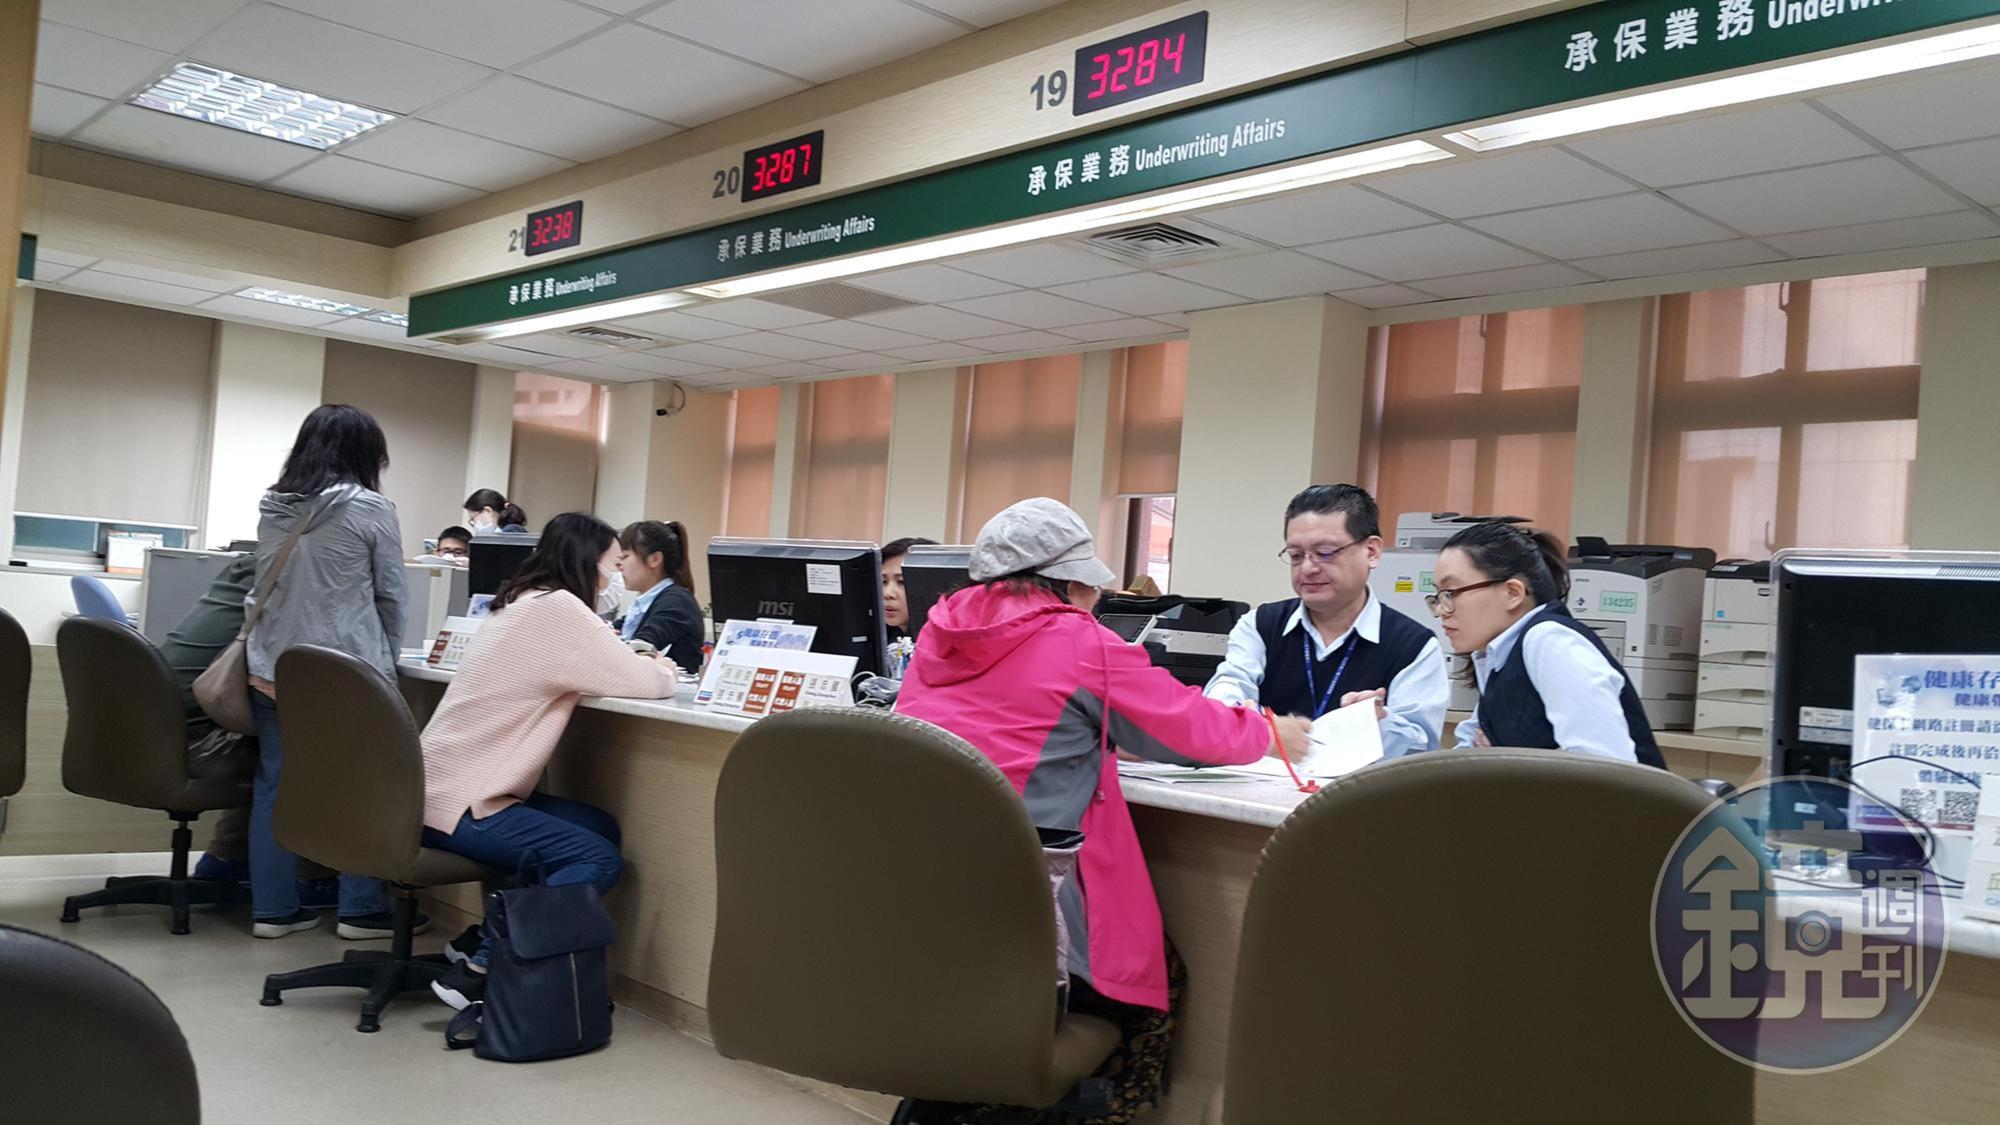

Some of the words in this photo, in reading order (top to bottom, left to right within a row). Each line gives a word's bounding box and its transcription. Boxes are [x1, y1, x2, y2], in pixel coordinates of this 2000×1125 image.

[1087, 33, 1186, 99] 3284
[1029, 69, 1068, 112] 19
[751, 143, 812, 192] 3287
[1027, 143, 1131, 197] 承保業務
[1135, 132, 1229, 172] Underwriting
[1232, 117, 1286, 149] Affairs
[712, 166, 740, 198] 20
[508, 226, 526, 252] 21
[531, 210, 574, 247] 3238
[717, 226, 783, 262] 承保業務
[785, 223, 842, 249] Underwriting
[842, 214, 875, 237] Affairs
[757, 600, 795, 617] msi
